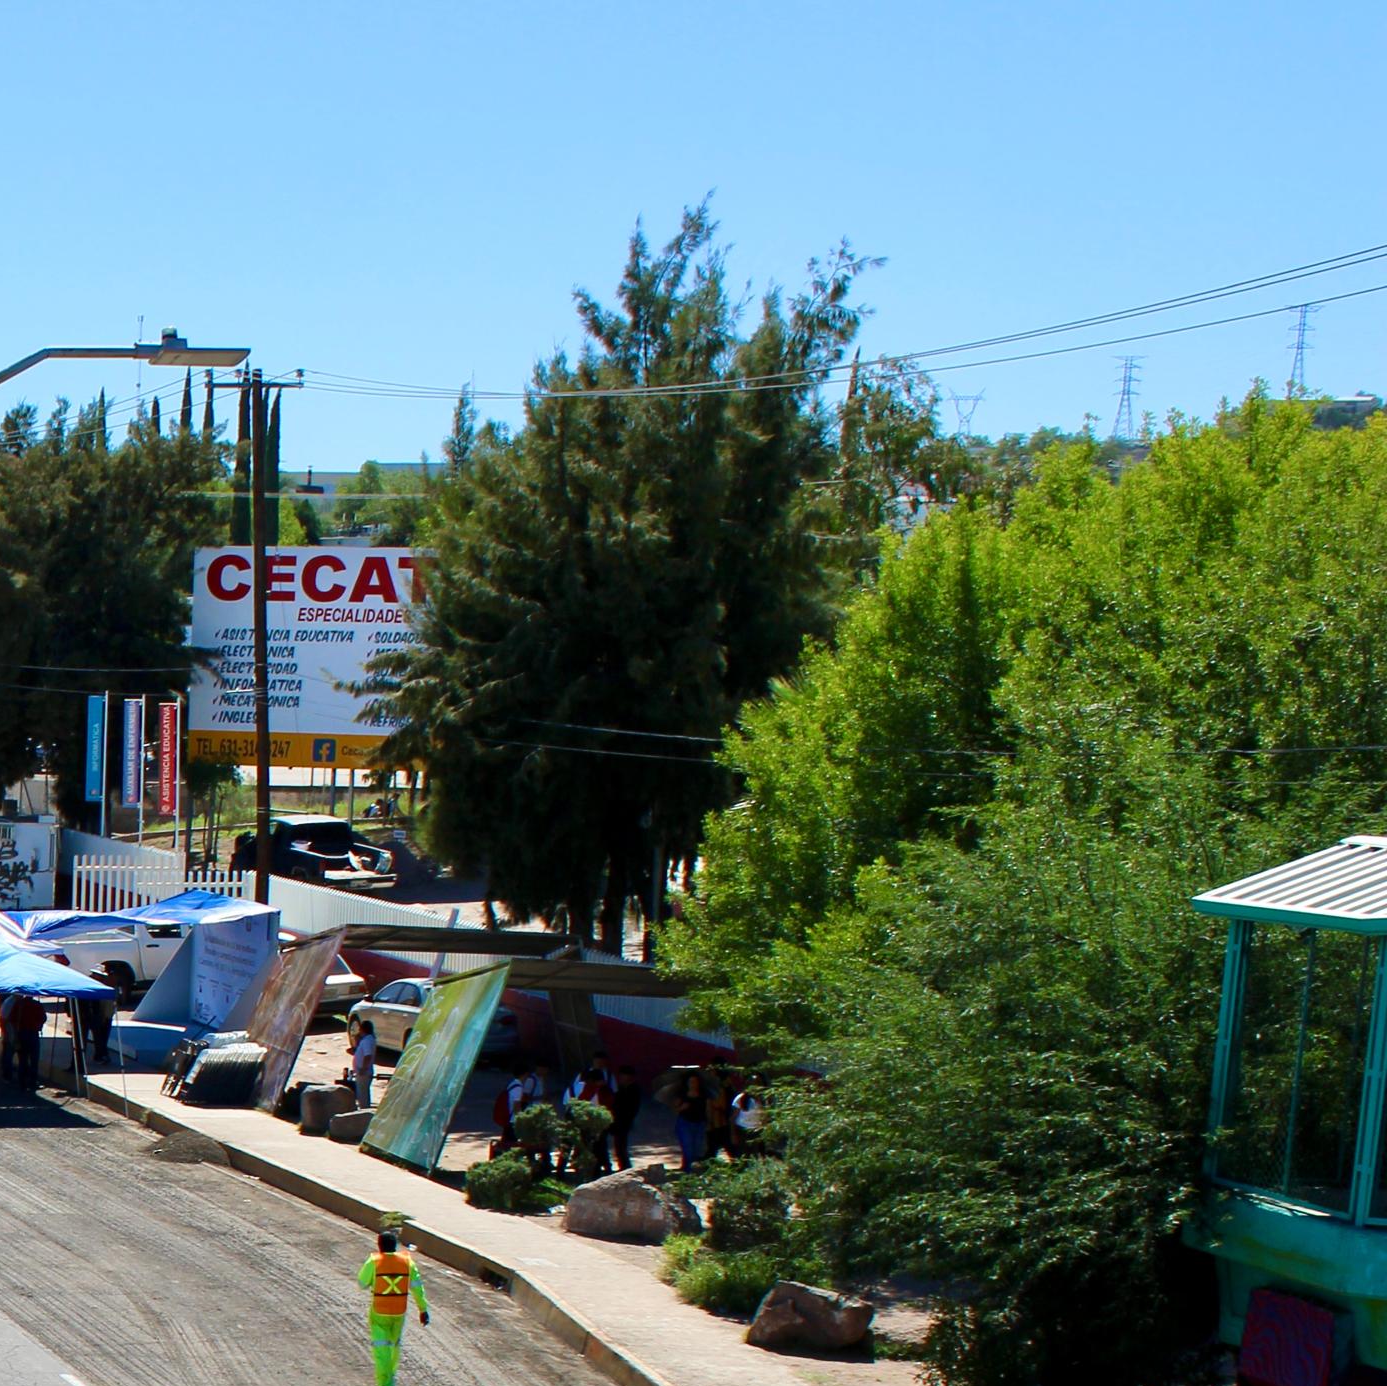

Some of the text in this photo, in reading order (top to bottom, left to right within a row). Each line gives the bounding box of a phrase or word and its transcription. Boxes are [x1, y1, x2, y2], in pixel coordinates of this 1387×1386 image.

[294, 629, 355, 643] EDUCATIVA
[162, 706, 171, 802] ASISTENCIA EDUCATIVA
